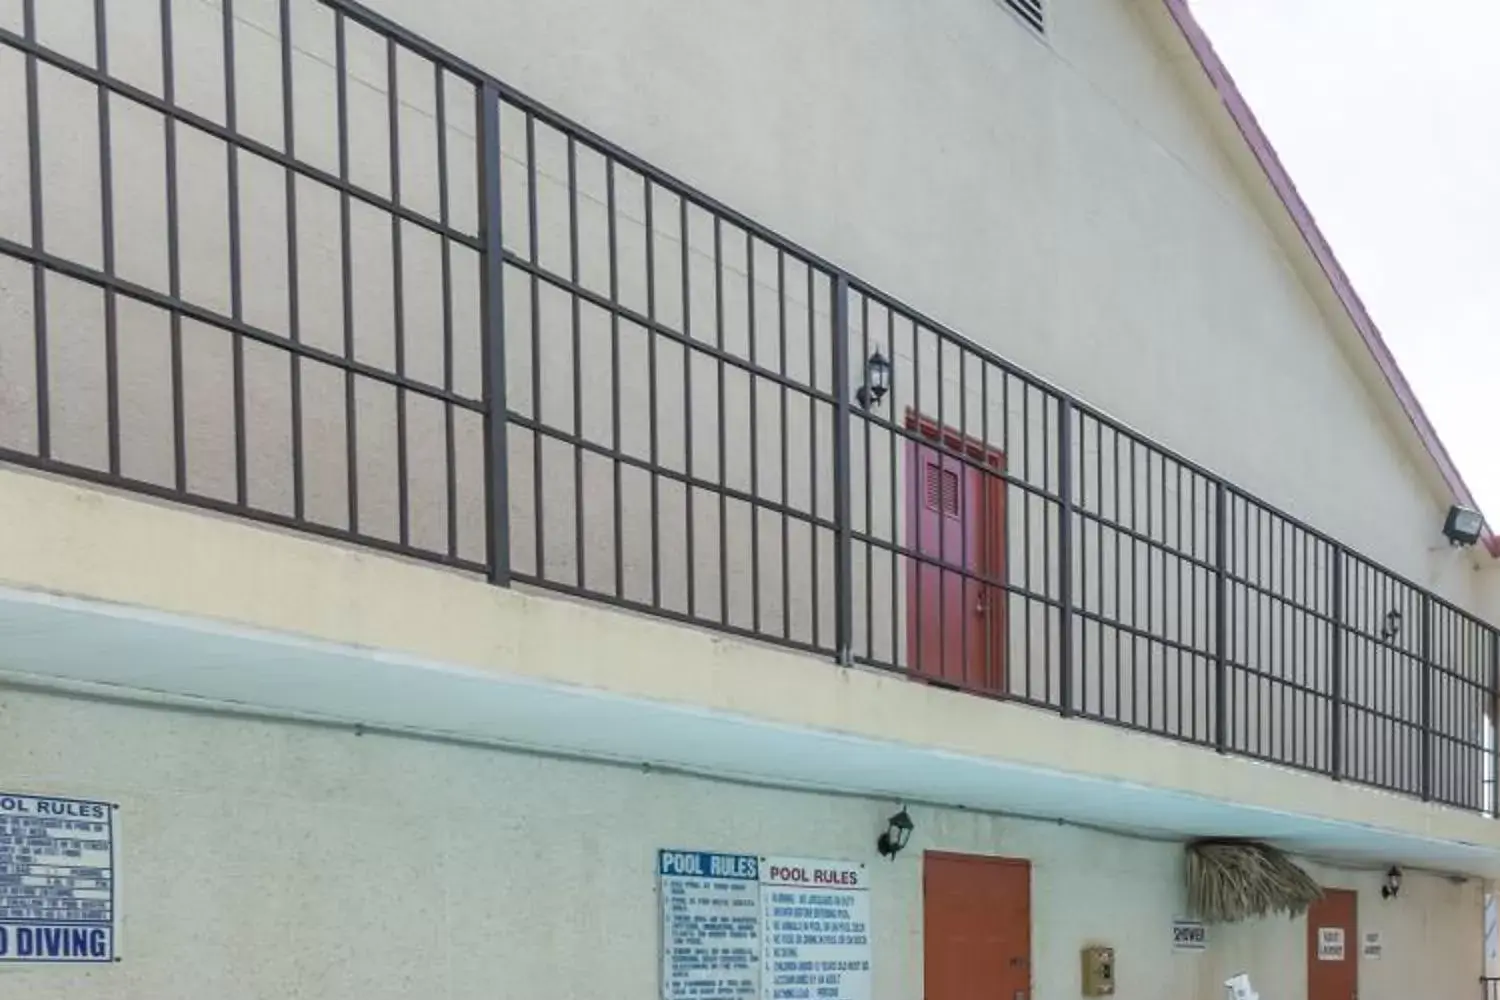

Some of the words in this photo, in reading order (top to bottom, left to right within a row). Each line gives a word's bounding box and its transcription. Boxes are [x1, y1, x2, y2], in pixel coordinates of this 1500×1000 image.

[37, 801, 104, 817] RULES
[663, 853, 704, 875] POOL
[711, 855, 755, 877] RULES
[770, 866, 809, 882] POOL
[814, 869, 857, 885] RULES
[16, 927, 105, 957] DIVING
